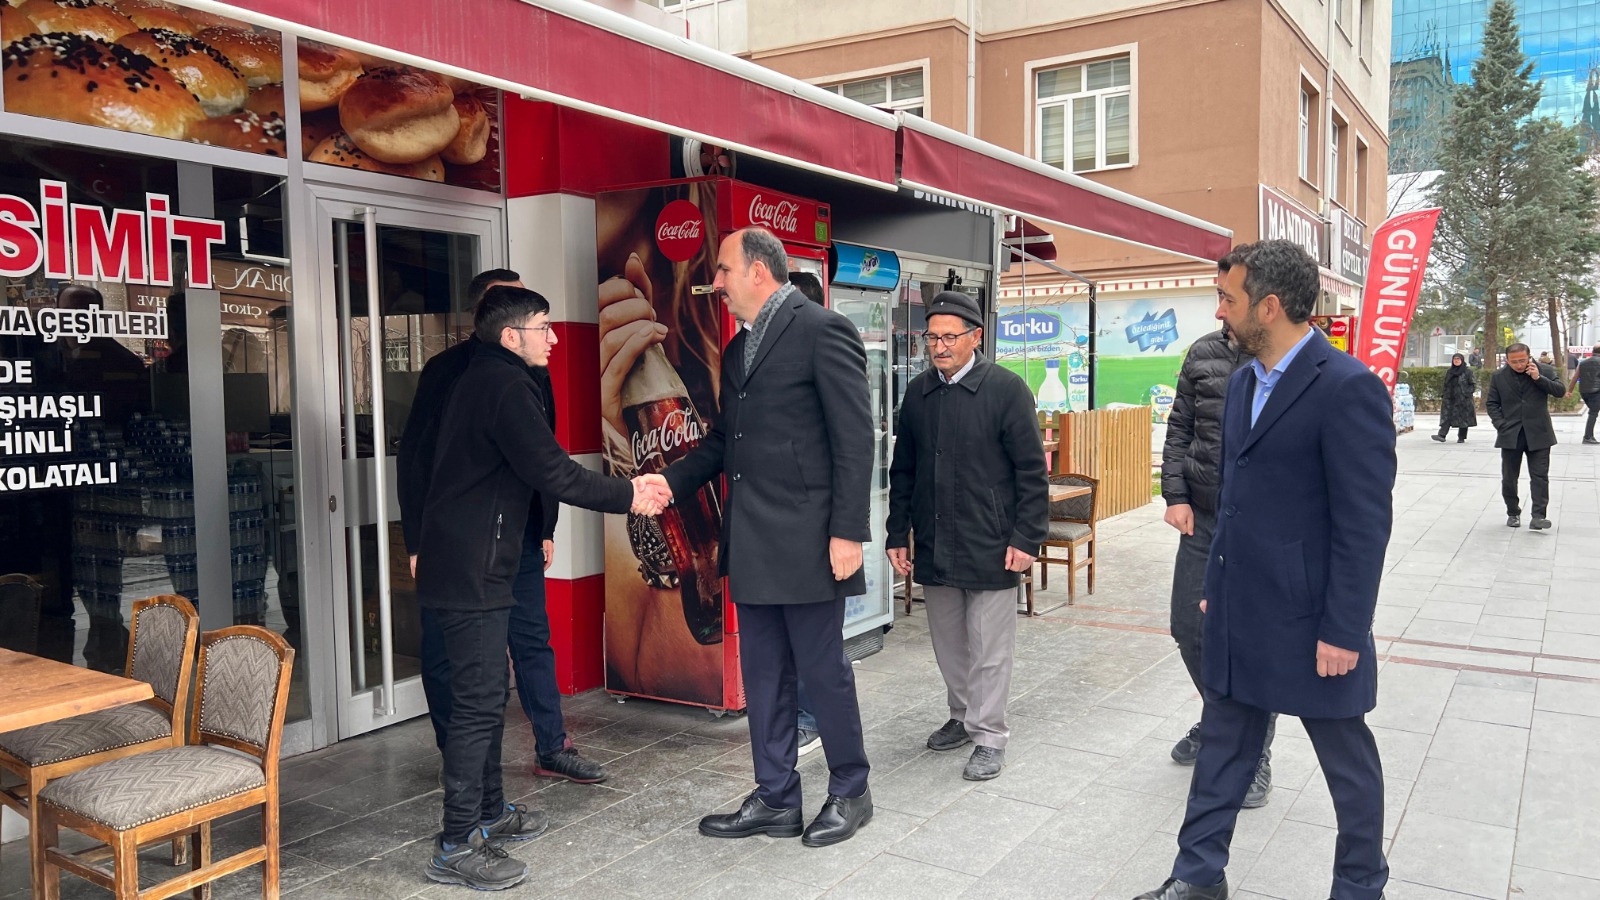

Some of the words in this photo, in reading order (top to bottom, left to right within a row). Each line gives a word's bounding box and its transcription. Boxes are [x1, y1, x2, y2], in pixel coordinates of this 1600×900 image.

[0, 178, 226, 289] SİMİT
[658, 219, 702, 241] Coca-Cola
[749, 194, 799, 233] Coca-Cola
[1268, 199, 1319, 262] MANDIRA
[1369, 228, 1420, 359] GÜNLÜK
[38, 304, 168, 343] ÇEŞİTLERİ
[1001, 316, 1053, 337] Torku
[631, 407, 702, 470] Coca-Cola
